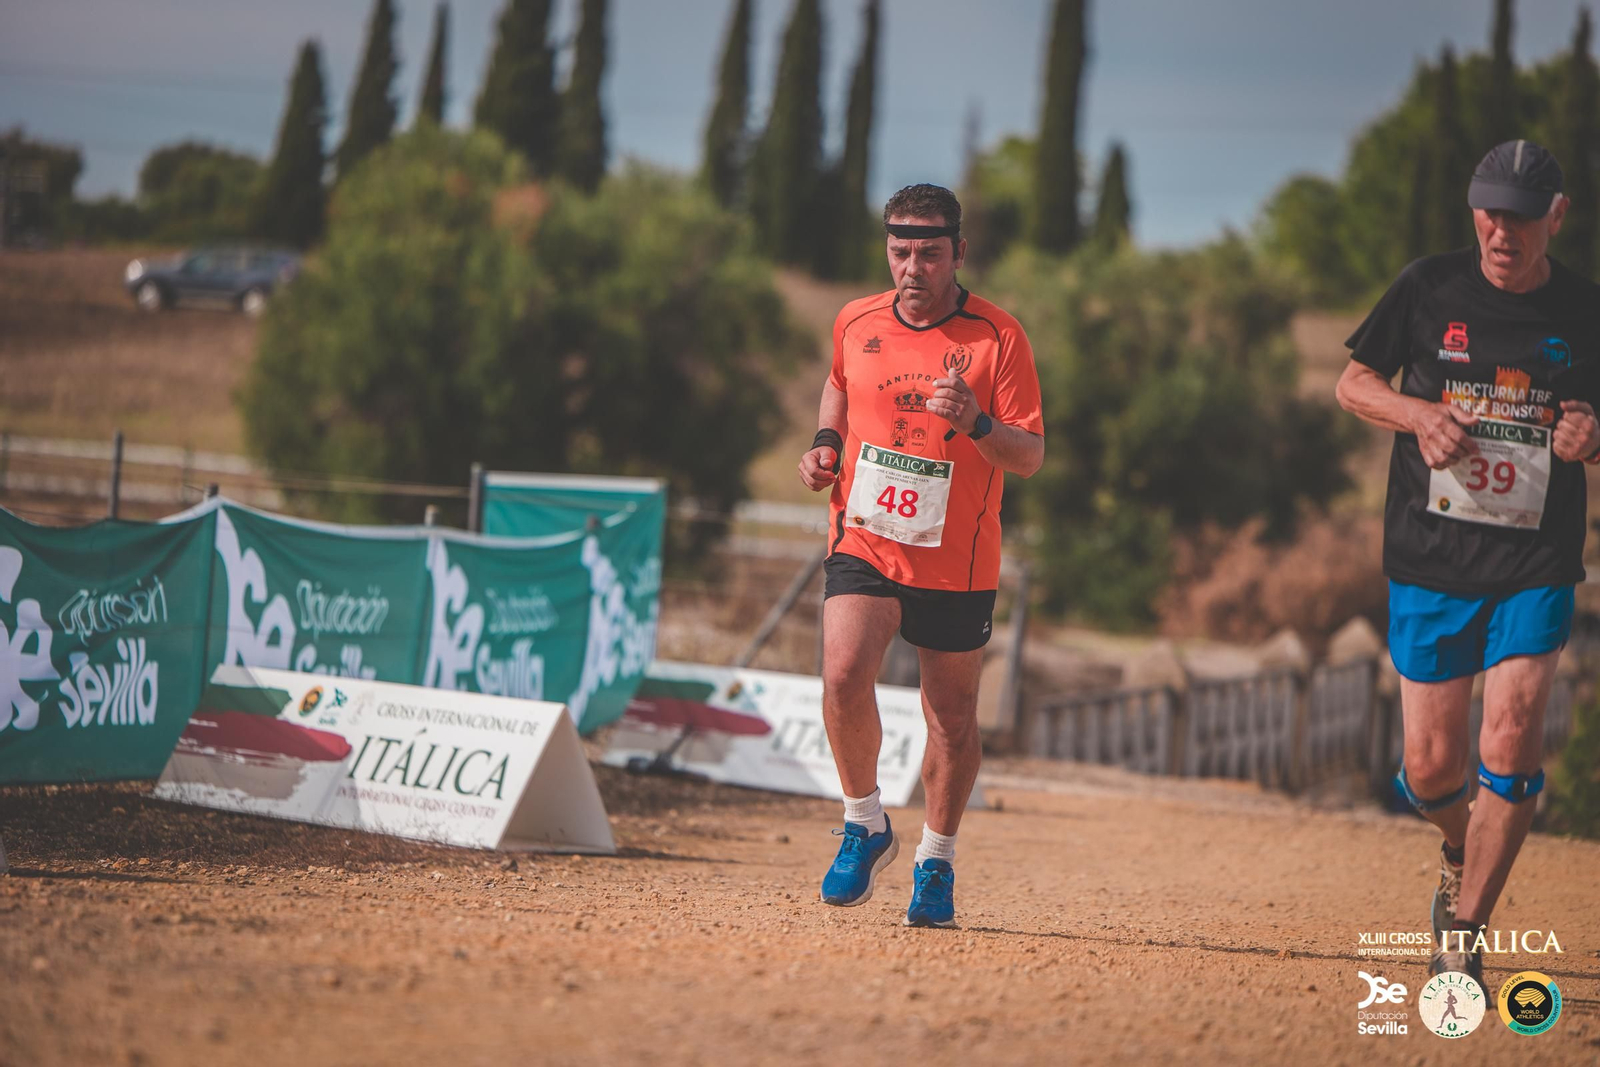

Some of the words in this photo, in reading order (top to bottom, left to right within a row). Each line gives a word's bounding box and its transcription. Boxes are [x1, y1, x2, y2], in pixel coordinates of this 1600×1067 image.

[1451, 380, 1527, 402] NOCTURNA
[1530, 388, 1553, 404] TBF
[1492, 401, 1544, 419] BONSOR
[881, 452, 926, 473] ITÁLICA
[1465, 457, 1516, 495] 39
[876, 485, 919, 518] 48
[377, 701, 415, 720] CROSS
[416, 708, 519, 735] INTERNACIONAL
[519, 720, 540, 737] DE
[346, 727, 511, 801] ITÁLICA
